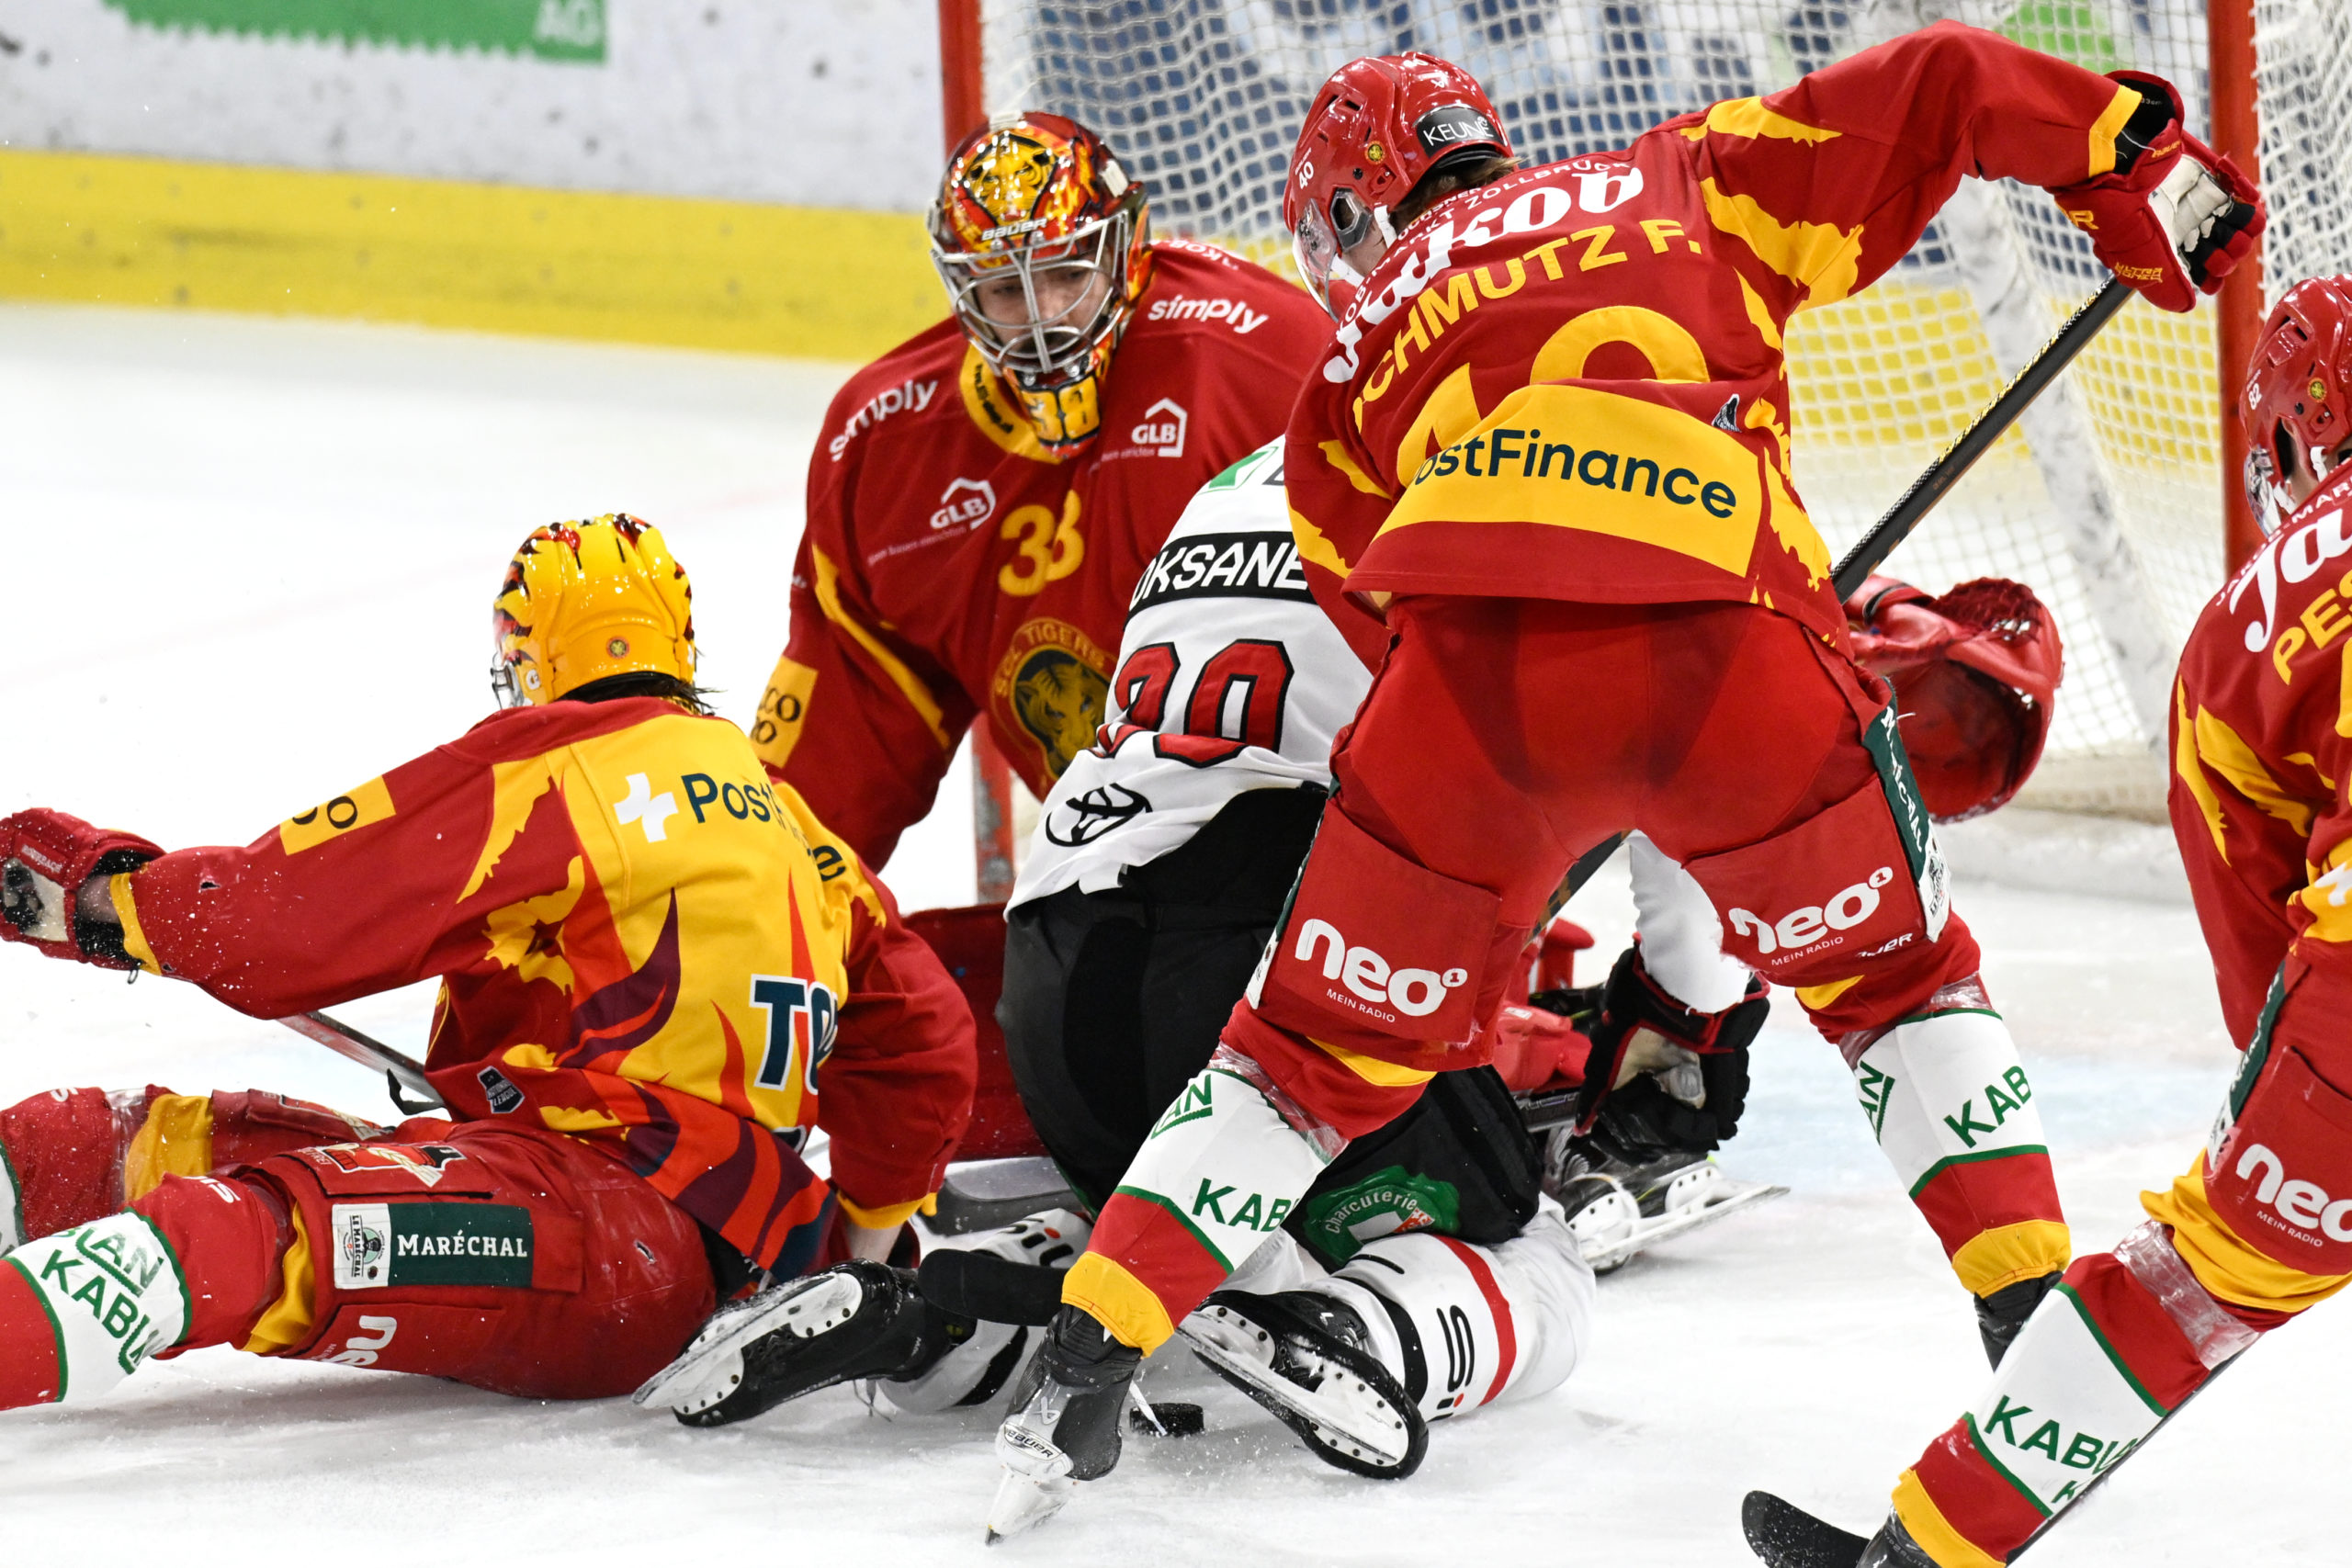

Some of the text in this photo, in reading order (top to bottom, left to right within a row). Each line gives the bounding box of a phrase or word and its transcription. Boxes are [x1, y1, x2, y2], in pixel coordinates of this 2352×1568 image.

[536, 0, 600, 45] AG
[1423, 120, 1494, 147] KEUNE
[1297, 161, 1315, 189] 40
[981, 218, 1047, 241] BAUER
[1640, 219, 1702, 255] F.
[1323, 166, 1644, 383] Jakob
[1148, 294, 1268, 334] simply
[830, 379, 938, 462] smply
[1131, 423, 1177, 444] GLB
[1412, 428, 1736, 519] ostFinance
[930, 498, 987, 529] GLB
[1129, 541, 1308, 612] OKSANE
[1771, 936, 1844, 966] MEIN RADIO
[1327, 988, 1396, 1023] MEIN RADIO
[1192, 1178, 1299, 1232] KAB
[1325, 1190, 1418, 1235] Charcuterie
[2256, 1211, 2324, 1247] MEIN RADIO
